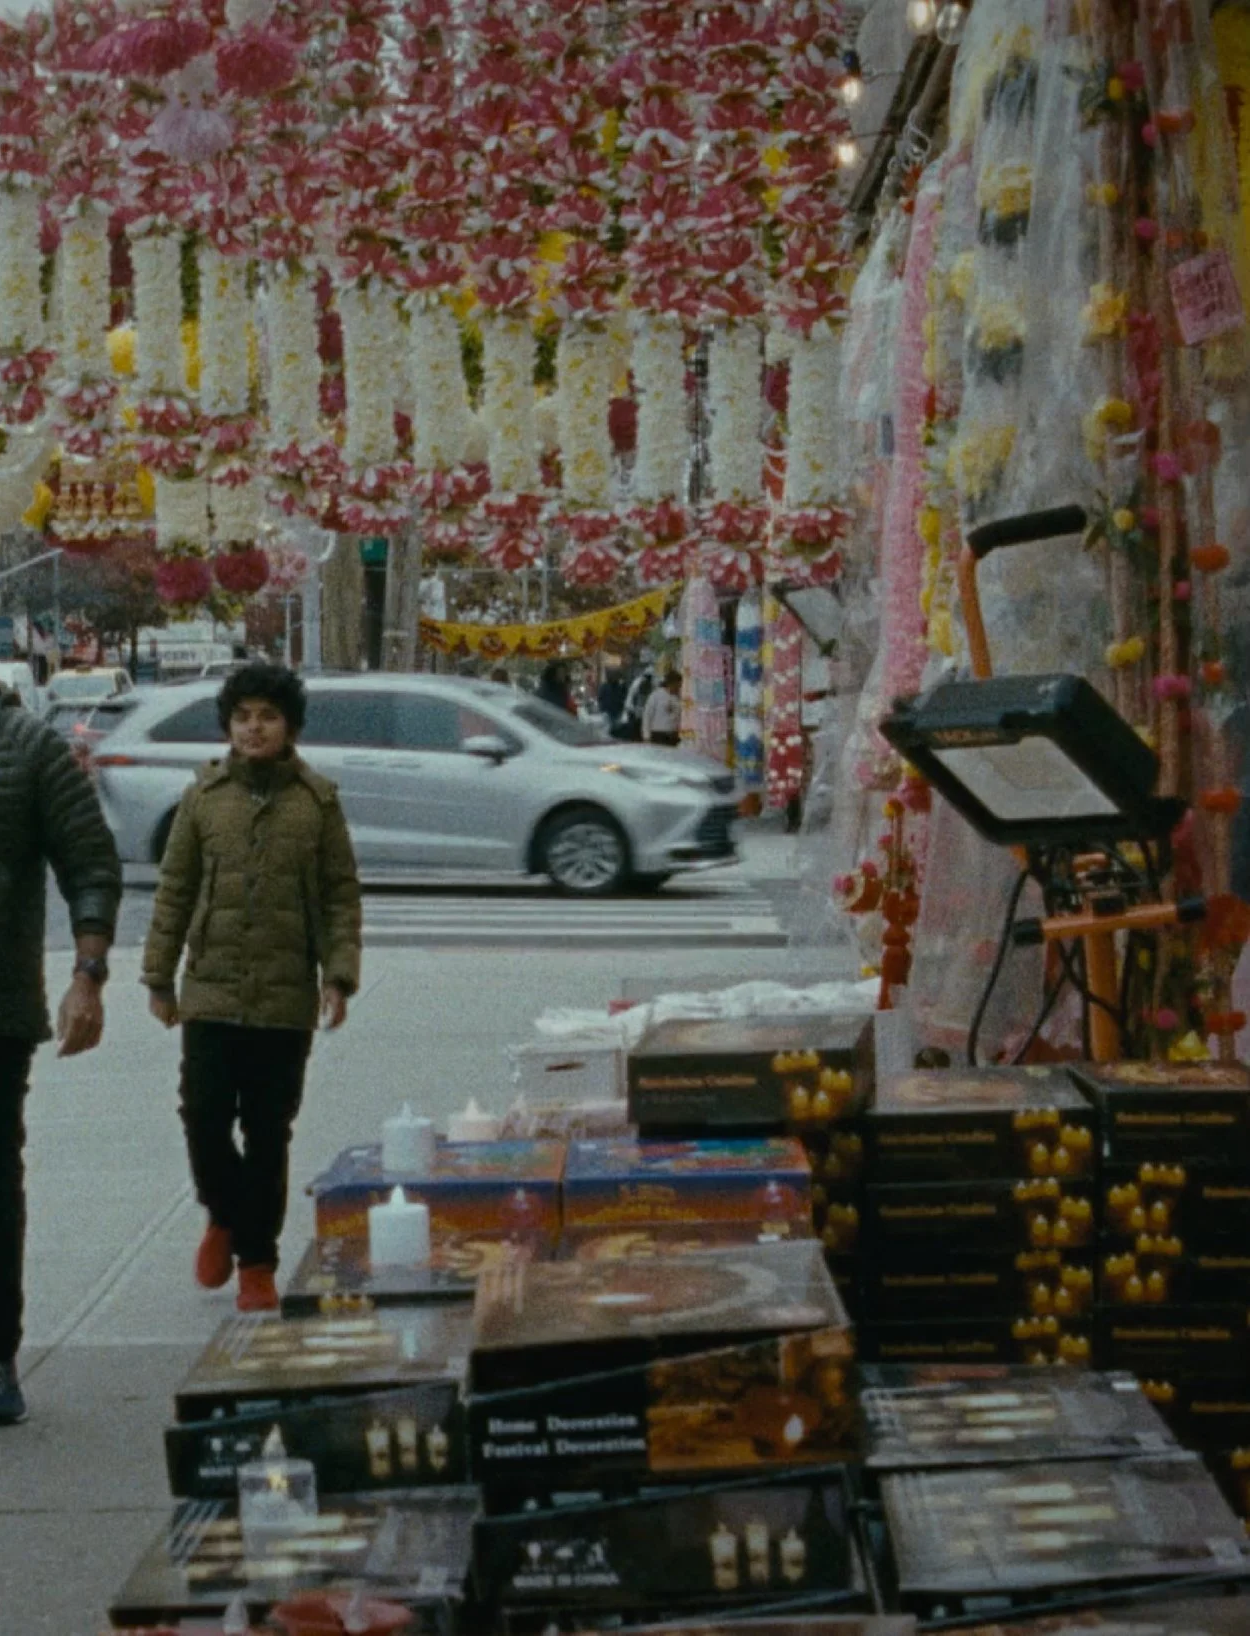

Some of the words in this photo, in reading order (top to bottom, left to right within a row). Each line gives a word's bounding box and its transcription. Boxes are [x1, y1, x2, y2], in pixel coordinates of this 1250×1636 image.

[488, 1416, 537, 1434] Home
[546, 1413, 638, 1432] Decoration
[482, 1438, 551, 1458] Festival
[555, 1435, 647, 1455] Decoration
[512, 1574, 553, 1589] MADE
[556, 1574, 573, 1587] IN
[575, 1571, 620, 1586] CHINA
